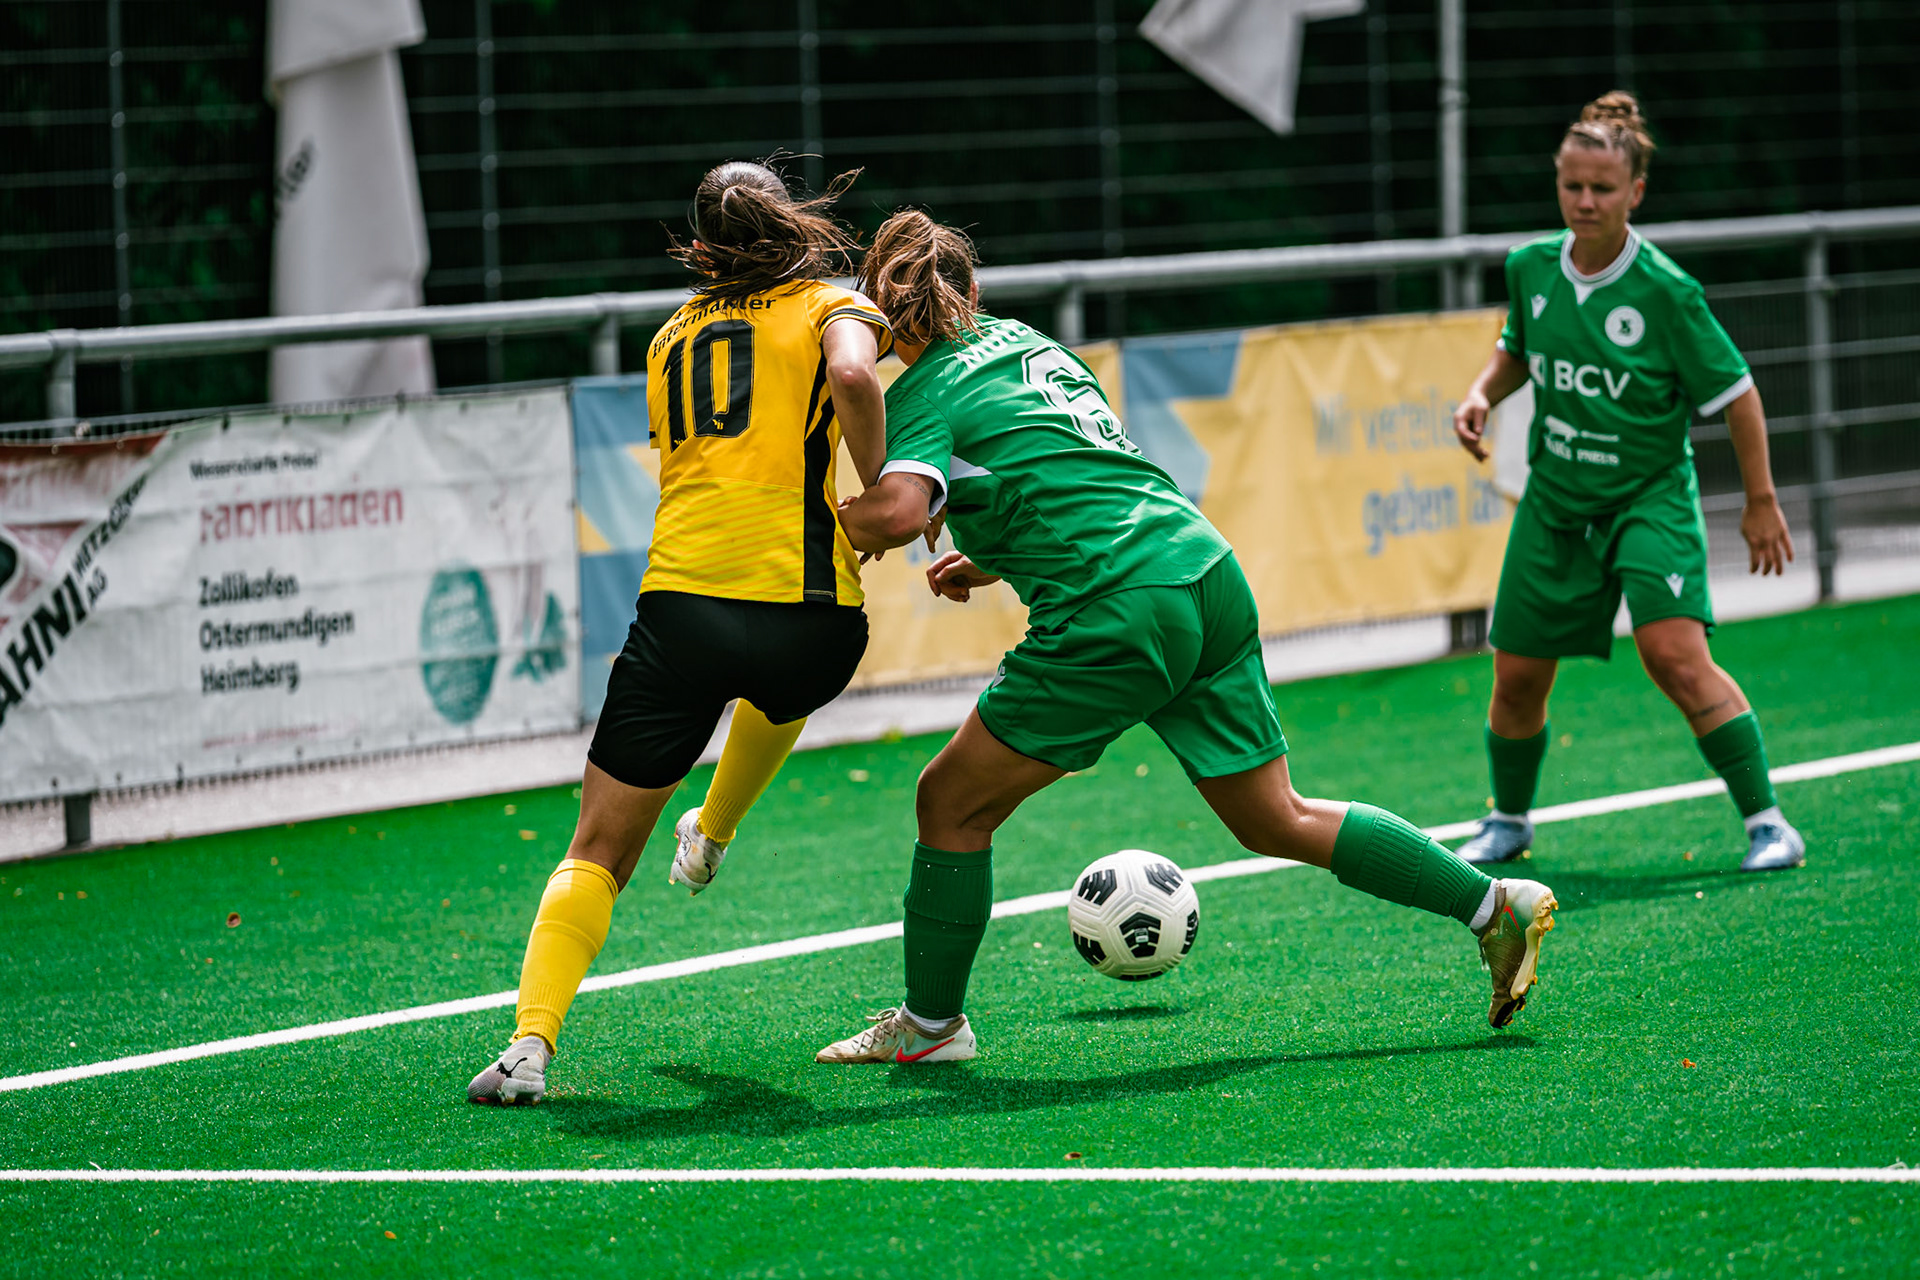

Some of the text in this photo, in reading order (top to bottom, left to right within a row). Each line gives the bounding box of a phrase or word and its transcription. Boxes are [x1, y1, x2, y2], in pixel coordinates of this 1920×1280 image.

[661, 318, 755, 454] 10
[1554, 359, 1631, 399] BCV
[199, 567, 298, 607] Zollikofen
[199, 606, 355, 650] Ostermundigen
[201, 657, 299, 696] Heimberg
